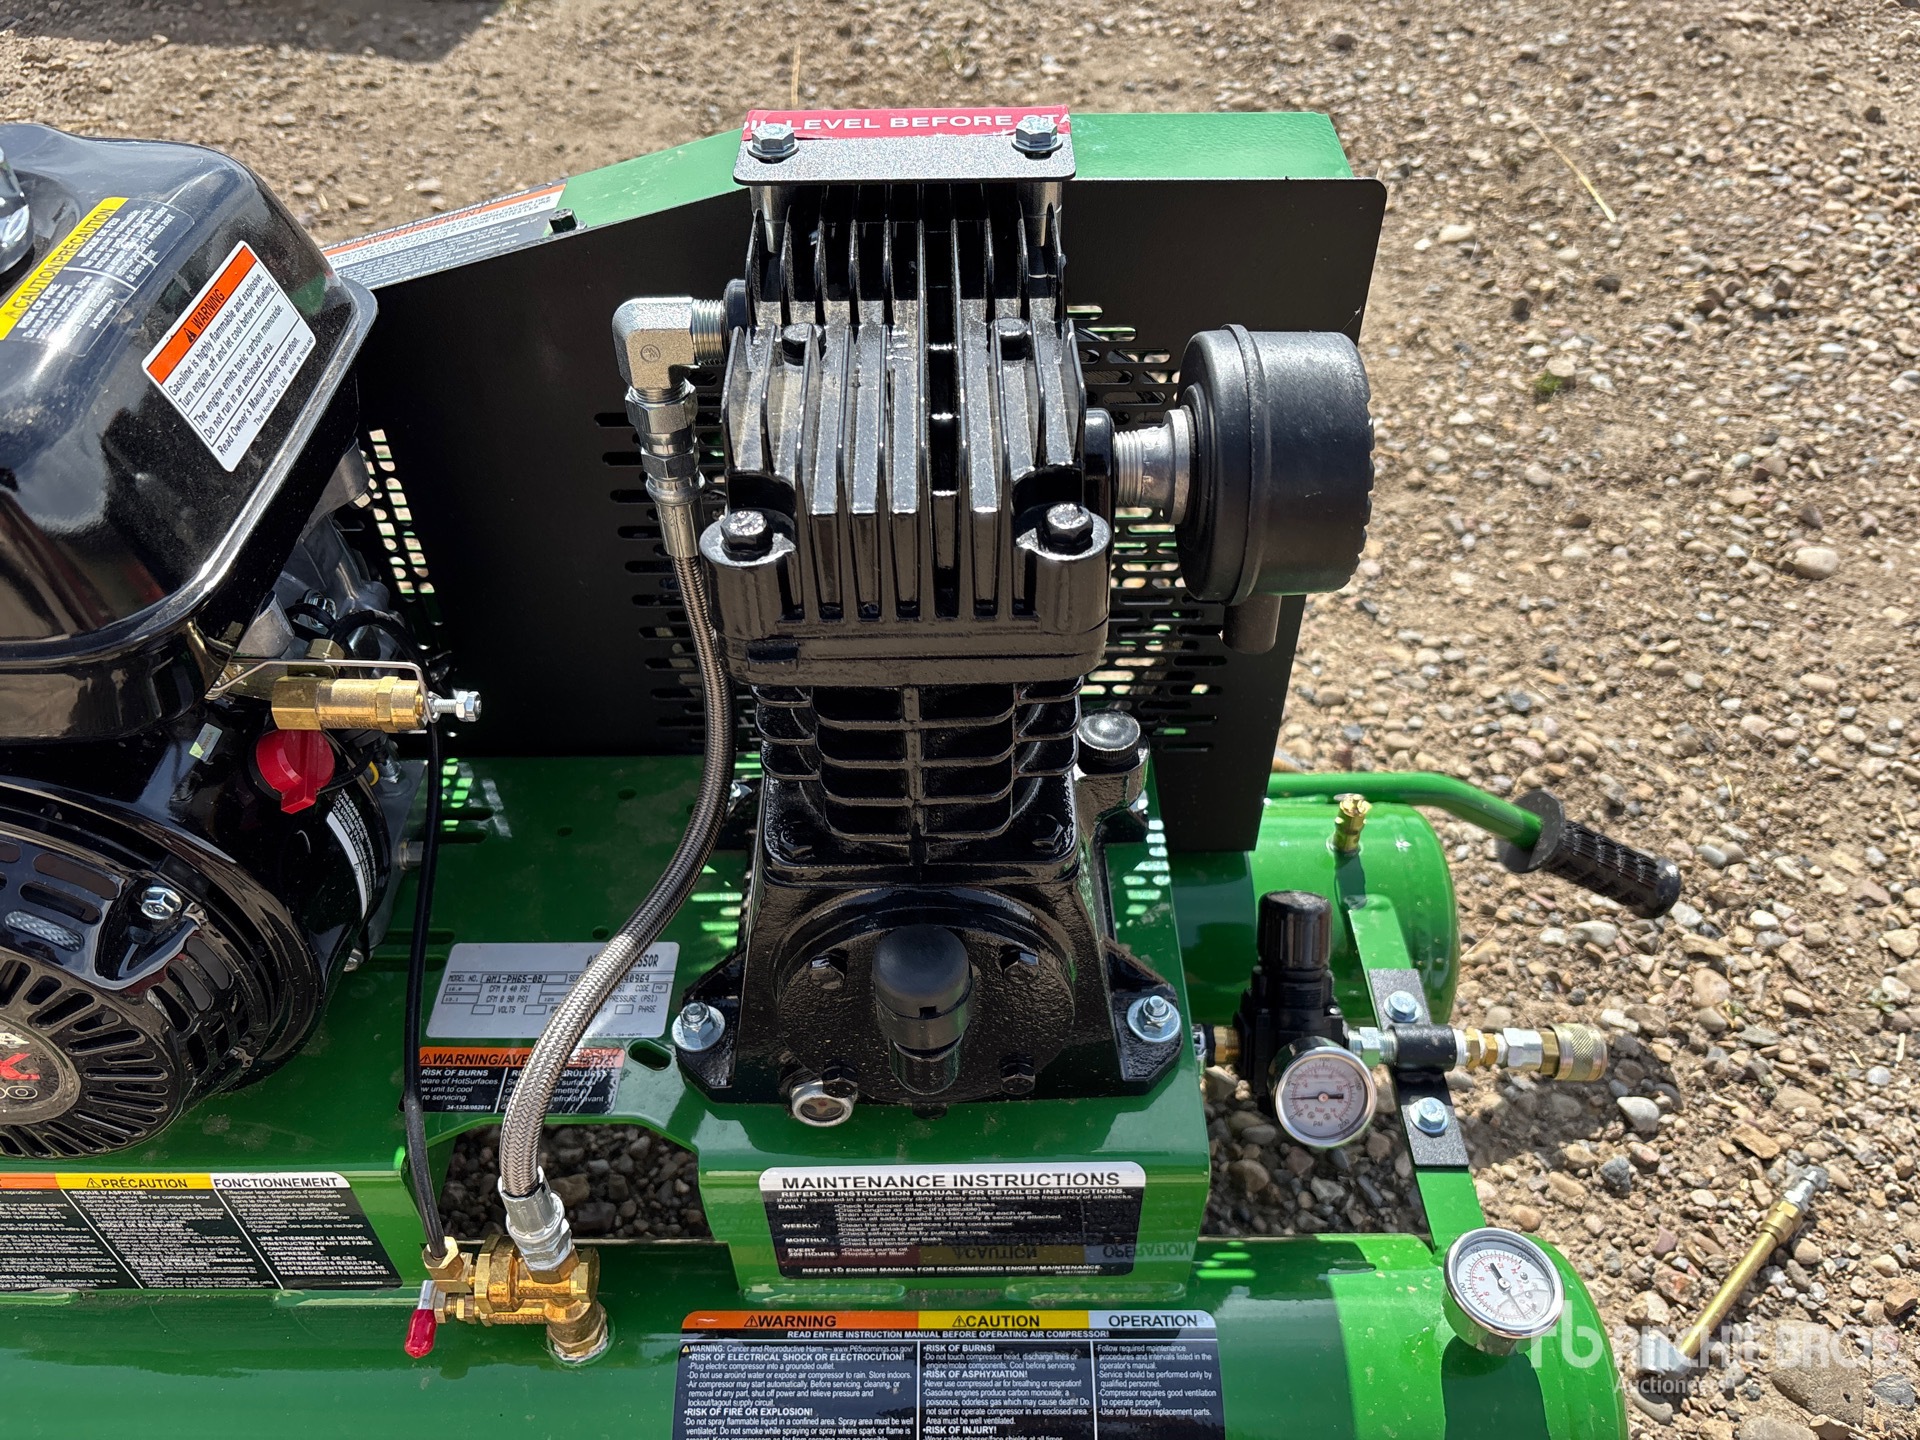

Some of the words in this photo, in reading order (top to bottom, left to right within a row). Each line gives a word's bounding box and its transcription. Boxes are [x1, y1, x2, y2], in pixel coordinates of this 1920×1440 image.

[786, 118, 880, 130] LEVEL
[890, 115, 1013, 128] BEFORE
[239, 270, 266, 303] explosive.
[190, 287, 226, 331] WARNING
[231, 295, 245, 313] and
[207, 307, 237, 344] flammable
[177, 387, 195, 409] Turn
[189, 366, 213, 394] engine
[206, 355, 219, 371] off
[213, 344, 227, 362] and
[221, 335, 233, 349] let
[228, 321, 244, 341] cool
[237, 303, 257, 327] before
[193, 337, 215, 364] highly
[259, 339, 275, 360] area.
[188, 356, 199, 369] is
[193, 407, 209, 427] The
[202, 385, 227, 415] engine
[219, 367, 238, 390] emits
[232, 351, 249, 372] toxic
[243, 329, 264, 356] carbon
[257, 301, 285, 335] monoxide.
[238, 354, 265, 387] enclosed
[167, 362, 195, 397] Gasoline
[216, 432, 235, 456] Read
[228, 405, 253, 437] Owner's
[246, 382, 270, 411] Manual
[262, 363, 283, 388] before
[275, 334, 304, 369] operation.
[227, 391, 238, 403] in
[233, 382, 245, 396] an
[219, 399, 233, 416] run
[252, 411, 265, 426] Thai
[260, 394, 277, 415] Honda
[210, 411, 224, 428] not
[202, 423, 216, 439] Do
[101, 1177, 188, 1188] PRÉCAUTION
[213, 1178, 338, 1188] FONCTIONNEMENT
[782, 1174, 946, 1188] MAINTENANCE
[953, 1172, 1120, 1187] INSTRUCTIONS
[758, 1316, 836, 1327] WARNING
[966, 1315, 1040, 1327] CAUTION
[1108, 1315, 1198, 1327] OPERATION
[948, 1370, 960, 1378] OF
[962, 1370, 1028, 1378] ASPHYXIATION!
[1156, 1371, 1188, 1379] performed
[1190, 1371, 1202, 1379] only
[1204, 1371, 1212, 1379] by
[1140, 1389, 1166, 1398] requires
[1167, 1389, 1183, 1398] good
[709, 1408, 721, 1416] OF
[723, 1408, 743, 1416] FIRE
[745, 1408, 758, 1416] OR
[760, 1408, 813, 1416] EXPLOSION!
[1115, 1408, 1128, 1417] only
[1130, 1408, 1151, 1417] factory
[1153, 1408, 1192, 1417] replacement
[1194, 1408, 1212, 1417] parts.
[948, 1426, 960, 1434] OF
[962, 1426, 997, 1434] INJURY!
